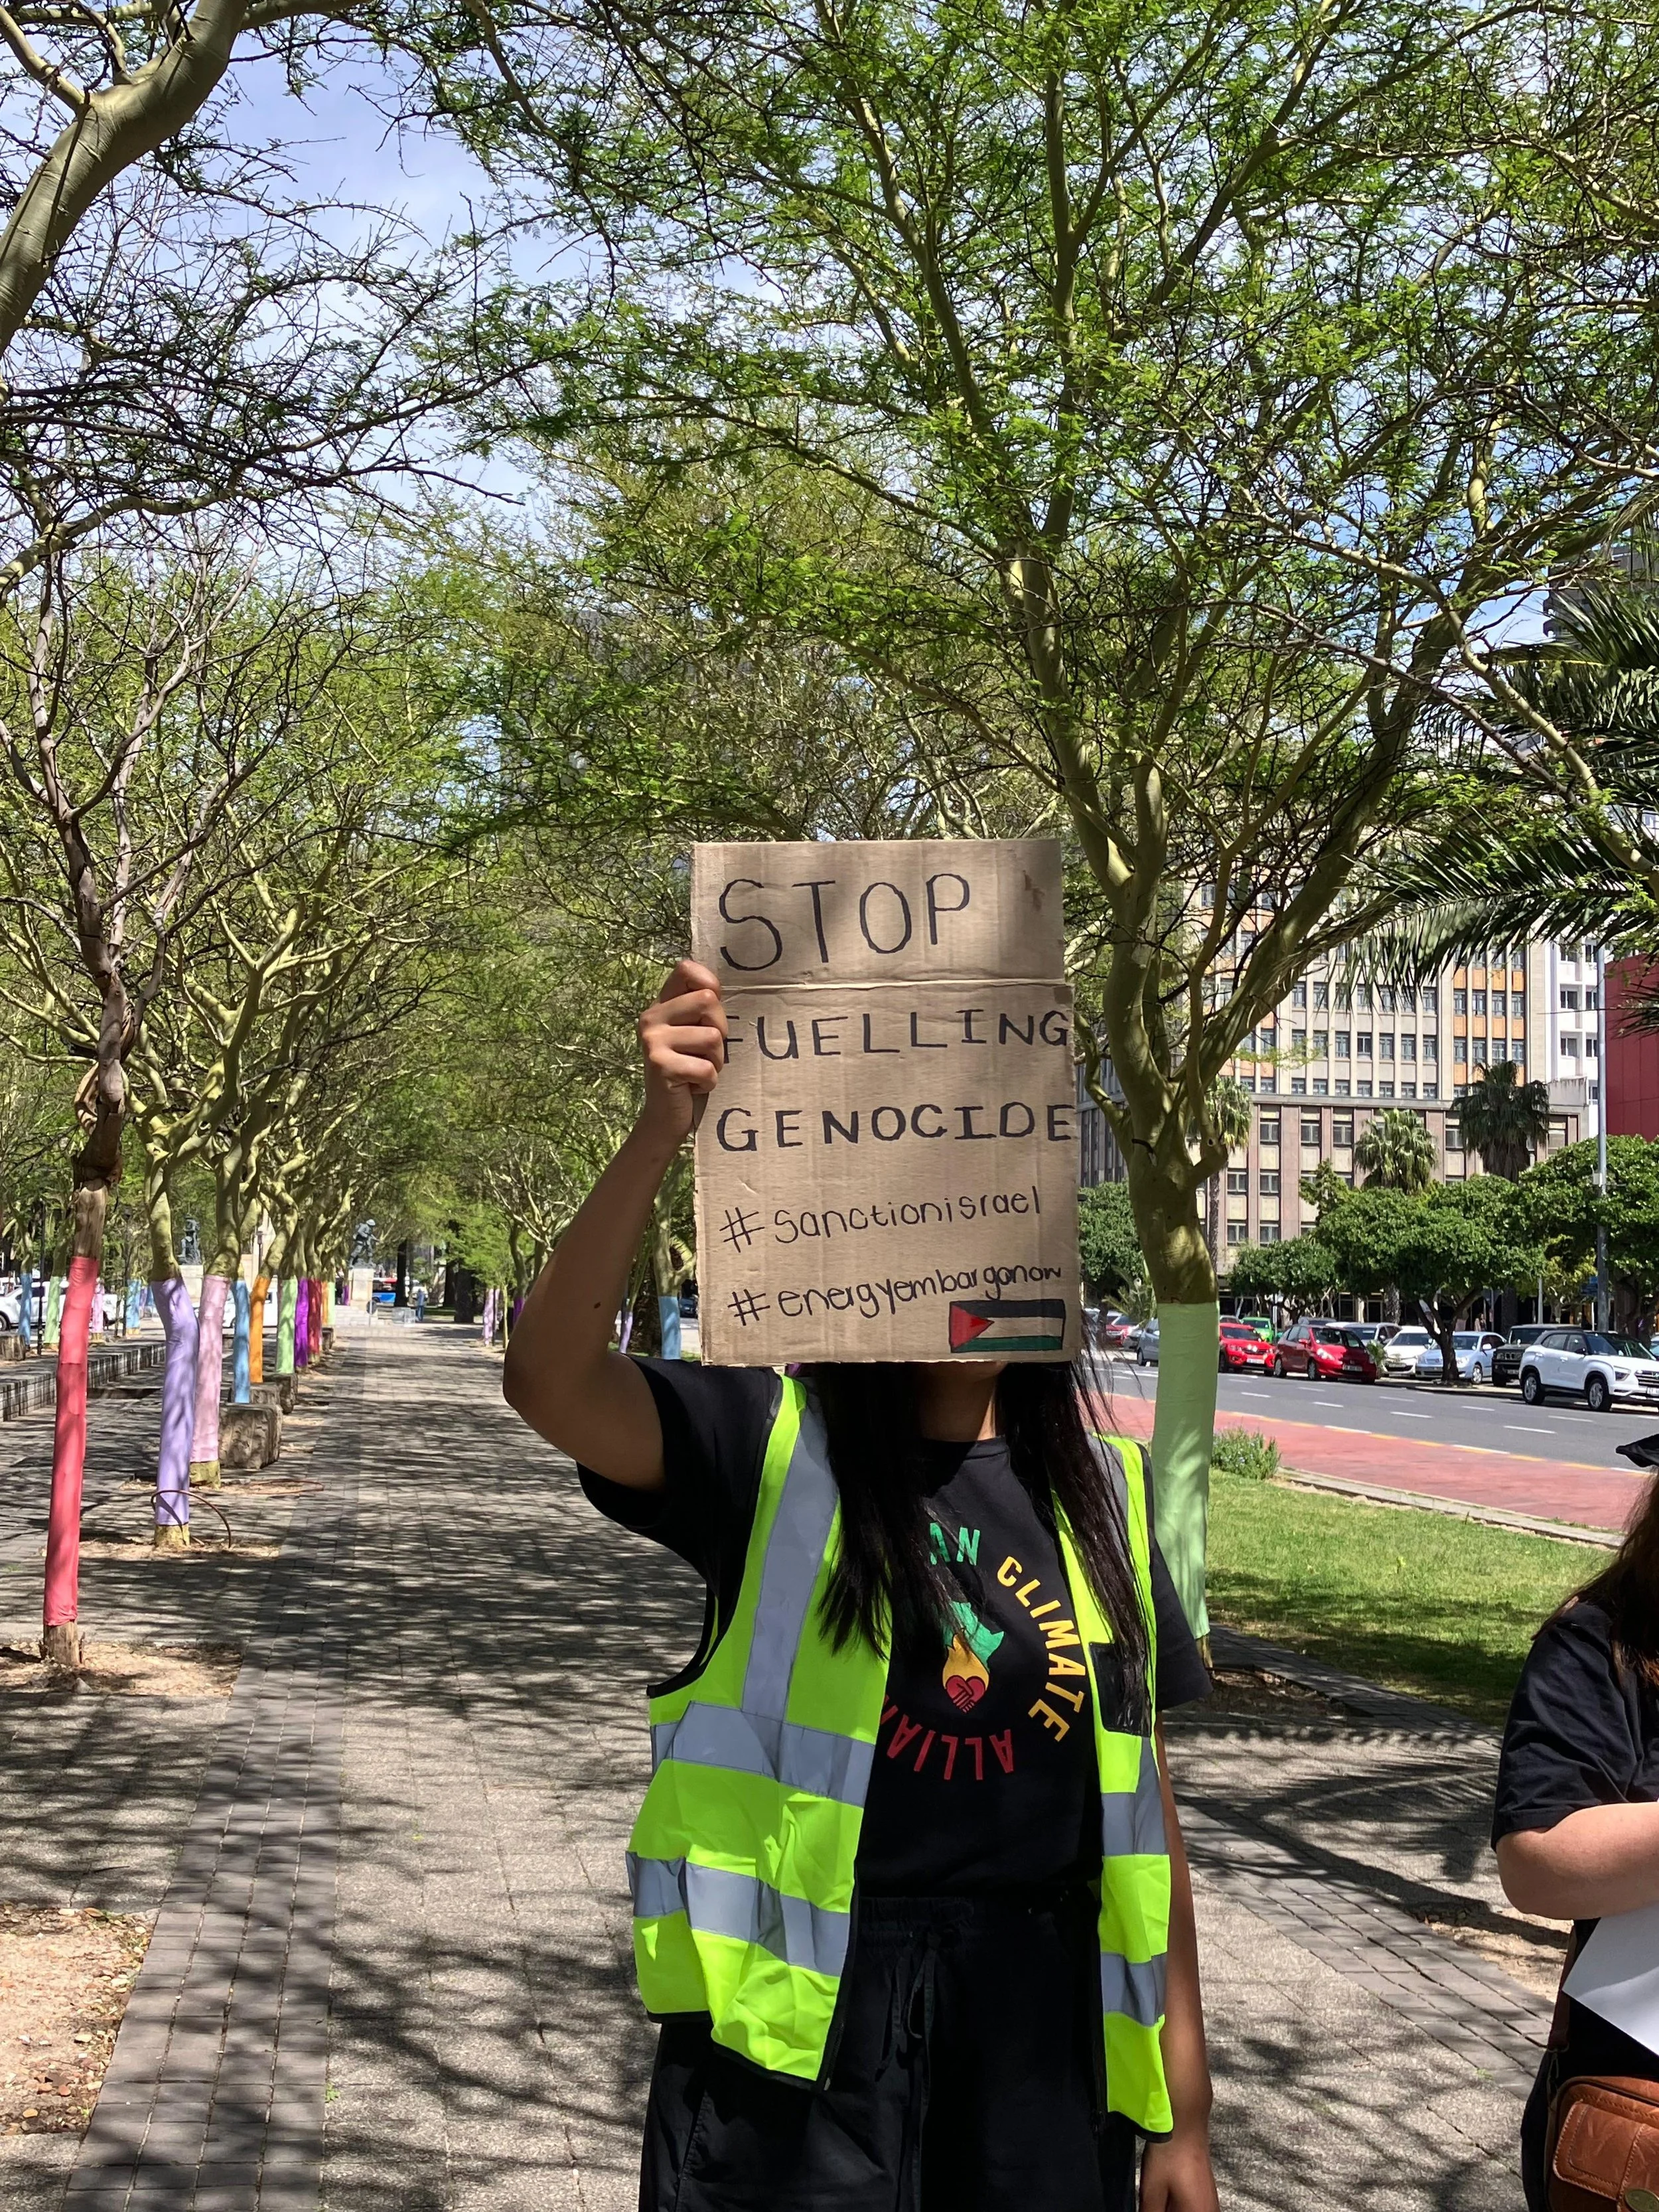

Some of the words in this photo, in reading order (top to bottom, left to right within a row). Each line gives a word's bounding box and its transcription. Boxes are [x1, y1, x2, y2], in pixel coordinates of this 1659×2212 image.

[719, 873, 970, 972] STOP
[723, 1009, 1069, 1064] FUELLING
[716, 1102, 1076, 1151] GENOCIDE
[997, 1556, 1087, 1742] CLIMATE
[880, 1694, 1015, 1781] ALLIA
